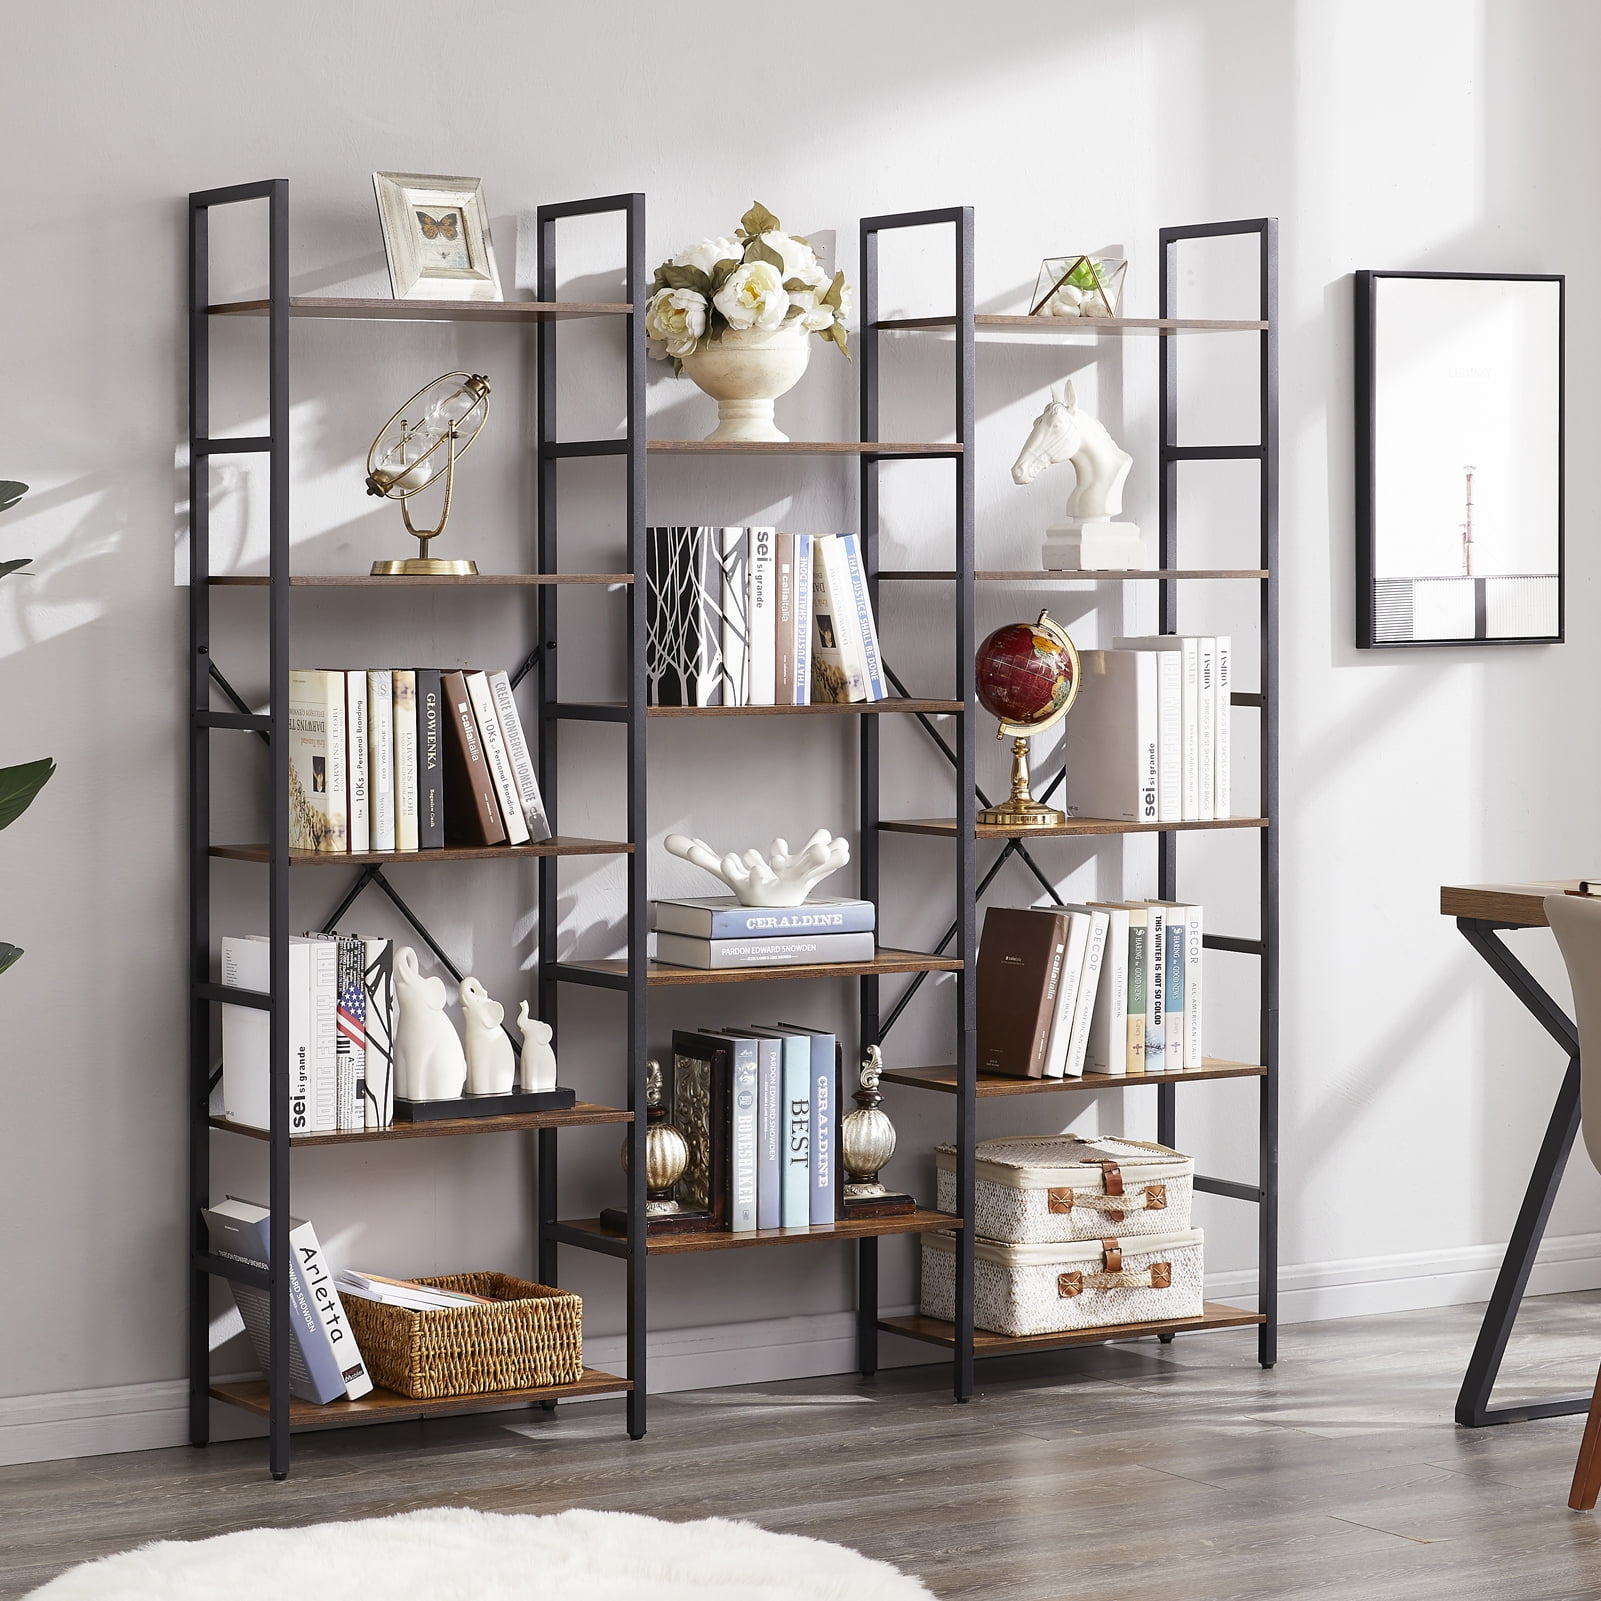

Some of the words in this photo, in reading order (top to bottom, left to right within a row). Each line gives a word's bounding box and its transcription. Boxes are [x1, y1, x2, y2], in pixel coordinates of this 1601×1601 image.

[756, 531, 772, 562] sei
[756, 564, 764, 572] si
[848, 554, 859, 578] THAT
[755, 573, 764, 608] grande
[800, 582, 807, 592] BE
[852, 579, 867, 616] JUSTICE
[799, 595, 807, 620] SHALL
[798, 624, 806, 659] JUSTICE
[860, 618, 871, 645] SHALL
[865, 645, 874, 656] BE
[869, 657, 879, 681] DONE
[495, 682, 511, 711] CREATE
[504, 712, 525, 762] WONDERFUL
[516, 762, 536, 803] HOMELIFE
[484, 718, 497, 743] 10Ks
[493, 749, 507, 782] Personal
[503, 784, 515, 816] Branding
[356, 777, 365, 802] 10Ks
[1143, 788, 1155, 816] sei
[1150, 777, 1155, 785] si
[746, 913, 844, 930] CERALDINE
[721, 946, 750, 956] PARDON
[751, 945, 781, 954] EDWARD
[782, 943, 817, 953] SNOWDEN
[1089, 927, 1103, 971] DECOR
[1190, 921, 1199, 964] DECOR
[1154, 989, 1162, 999] SO
[298, 1046, 307, 1082] grande
[299, 1084, 305, 1093] si
[290, 1095, 306, 1128] sei
[790, 1098, 810, 1169] BEST
[738, 1115, 753, 1205] BONESHAKER
[299, 1247, 343, 1344] Arletta
[296, 1292, 316, 1333] SNOWDEN
